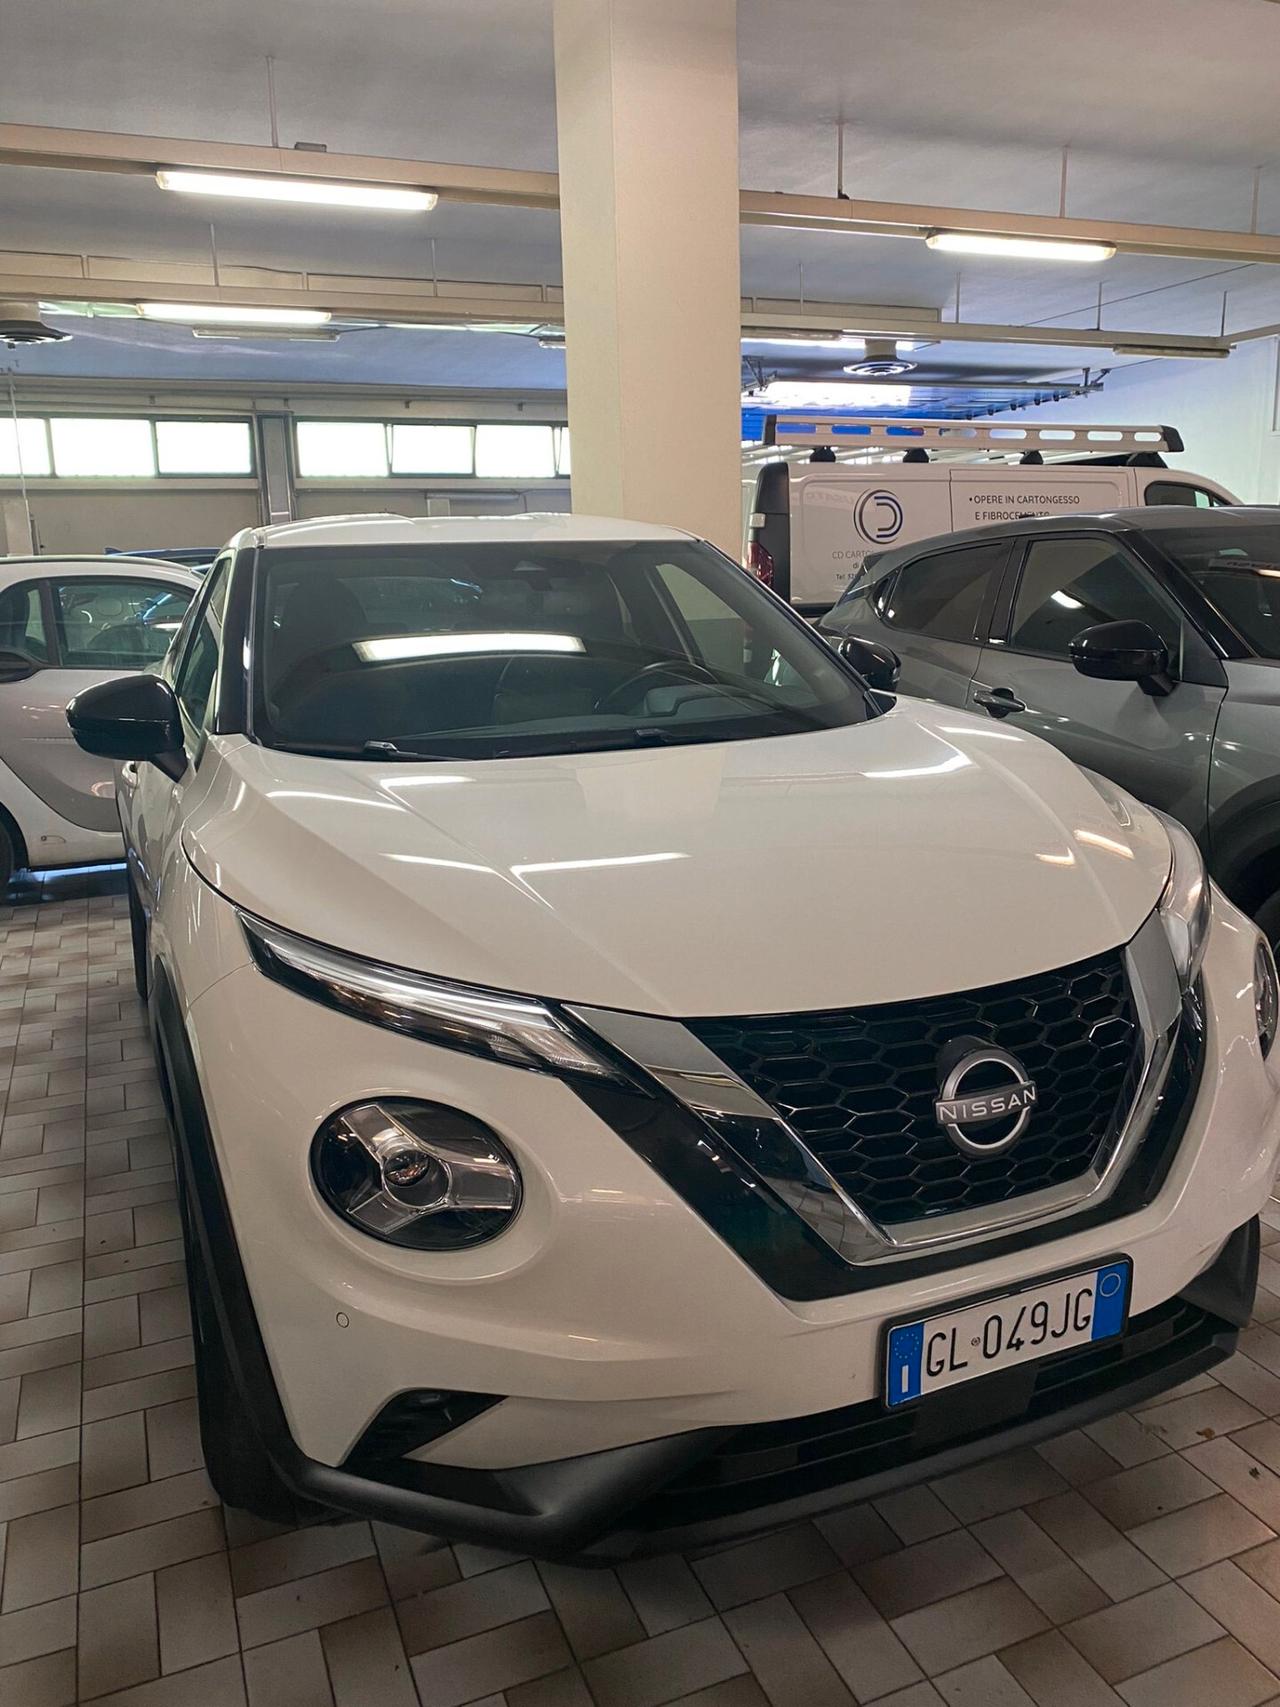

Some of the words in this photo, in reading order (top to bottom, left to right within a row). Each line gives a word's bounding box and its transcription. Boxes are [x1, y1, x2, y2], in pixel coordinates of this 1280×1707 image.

[1005, 495, 1015, 504] IN
[1017, 495, 1080, 504] CARTONGESSO
[974, 511, 981, 520] E
[831, 551, 844, 559] CD
[939, 1086, 1037, 1121] NISSAN
[926, 1327, 968, 1377] GL
[982, 1287, 1093, 1360] 049JG
